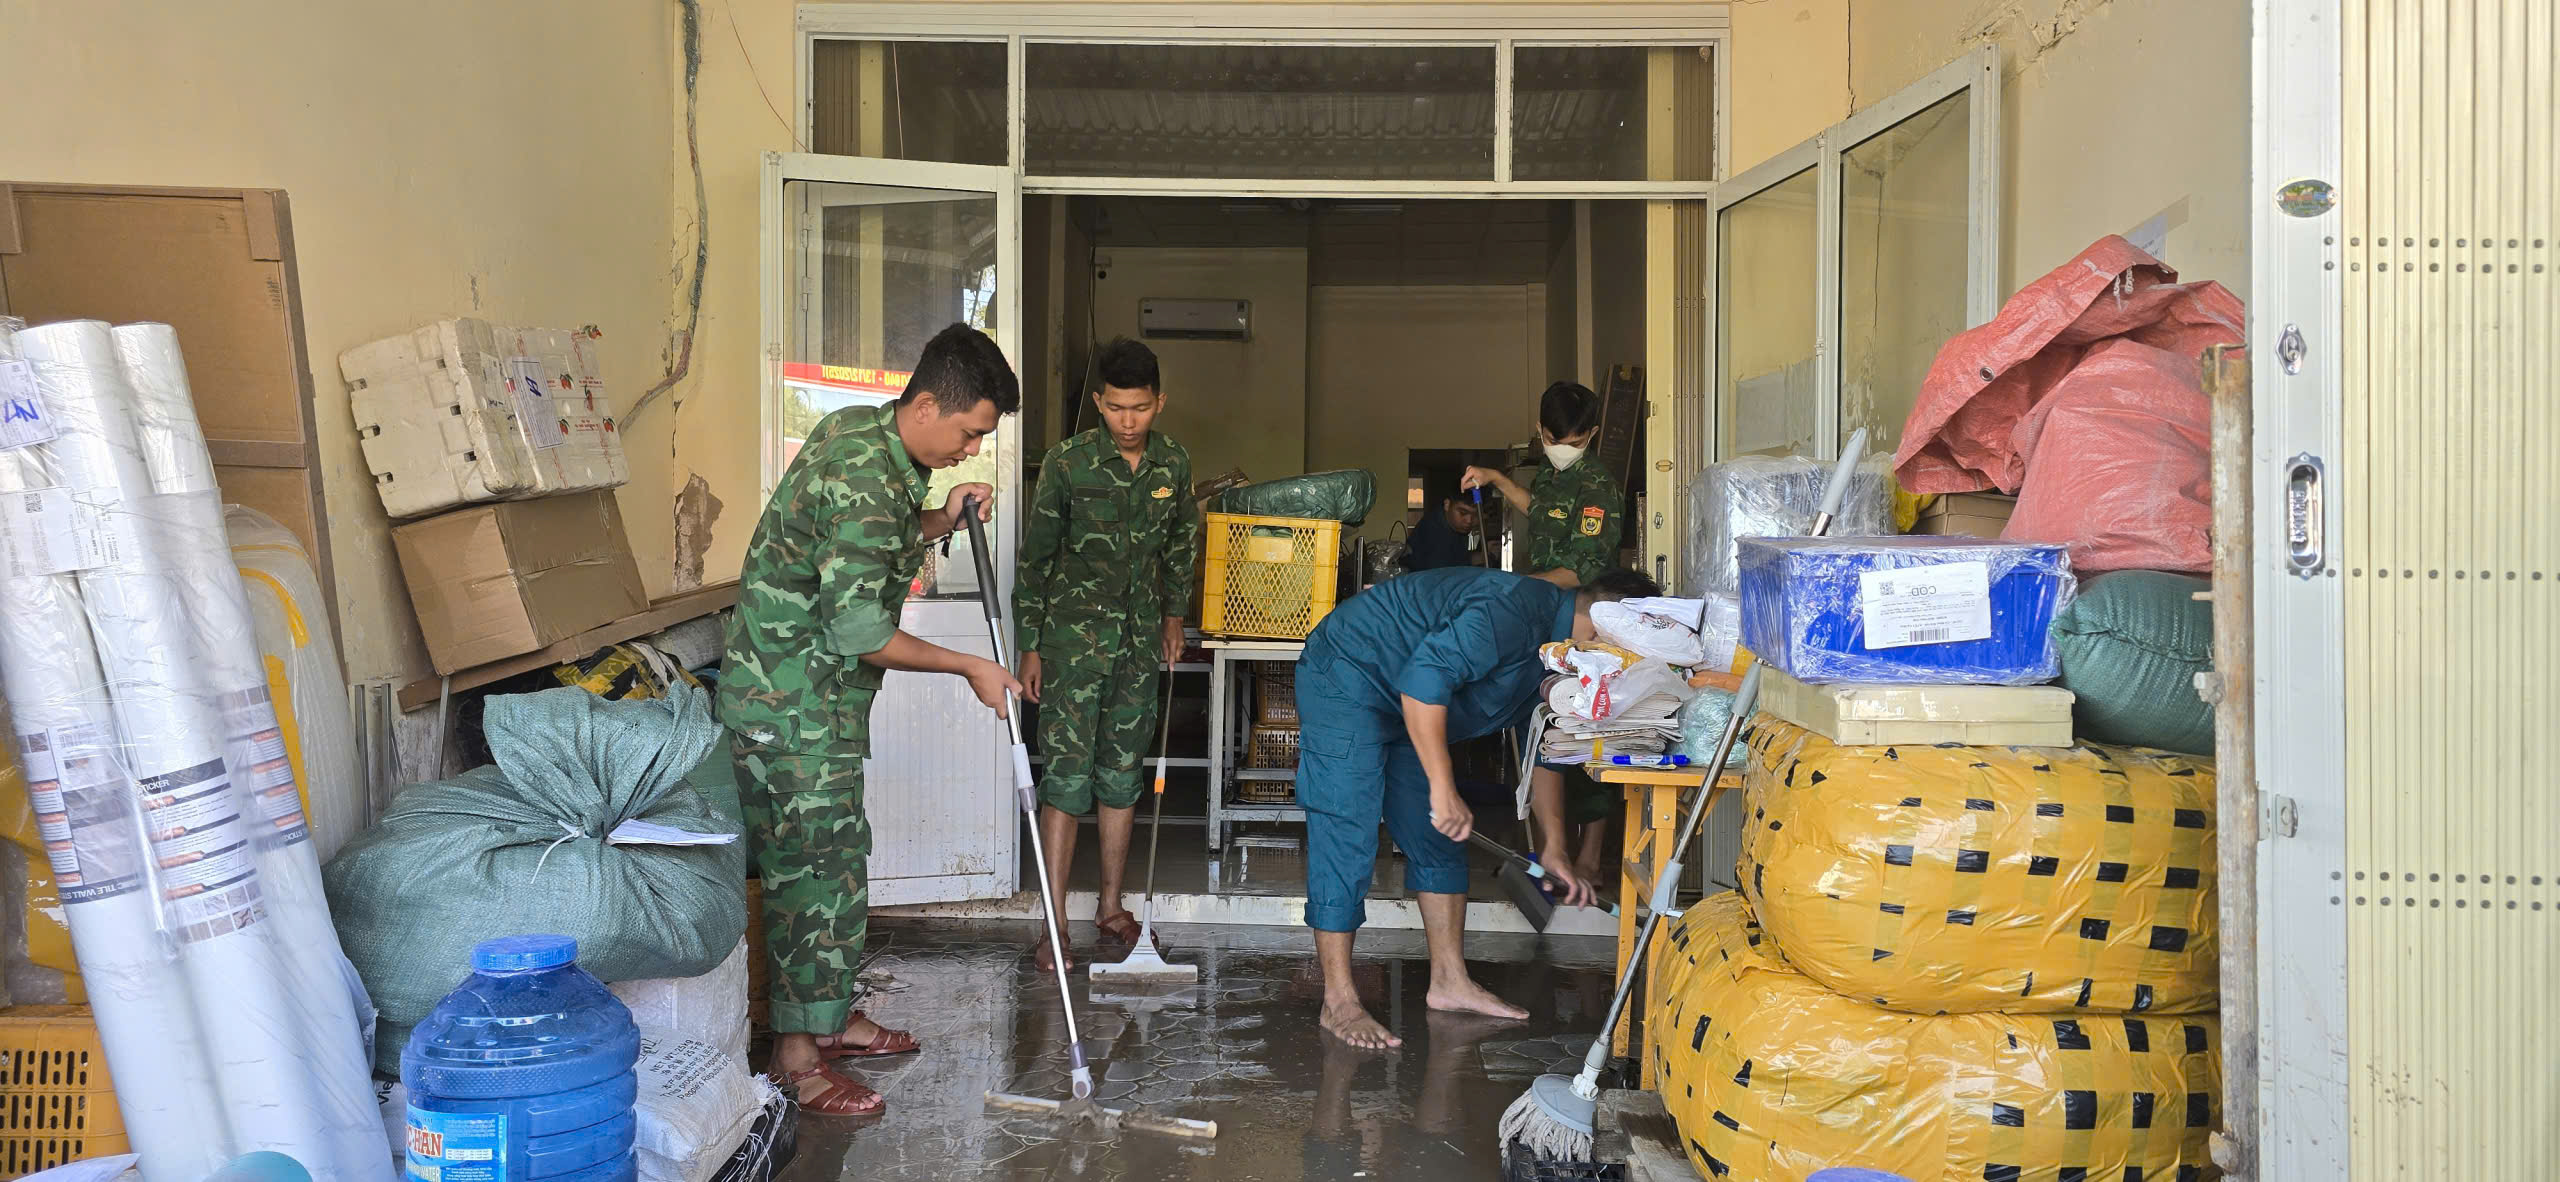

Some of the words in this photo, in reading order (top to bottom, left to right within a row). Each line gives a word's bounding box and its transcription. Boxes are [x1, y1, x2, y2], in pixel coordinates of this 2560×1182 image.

[1911, 585, 1936, 597] COD
[72, 887, 97, 900] WALL
[98, 882, 117, 894] TILE
[377, 1081, 394, 1105] Vie
